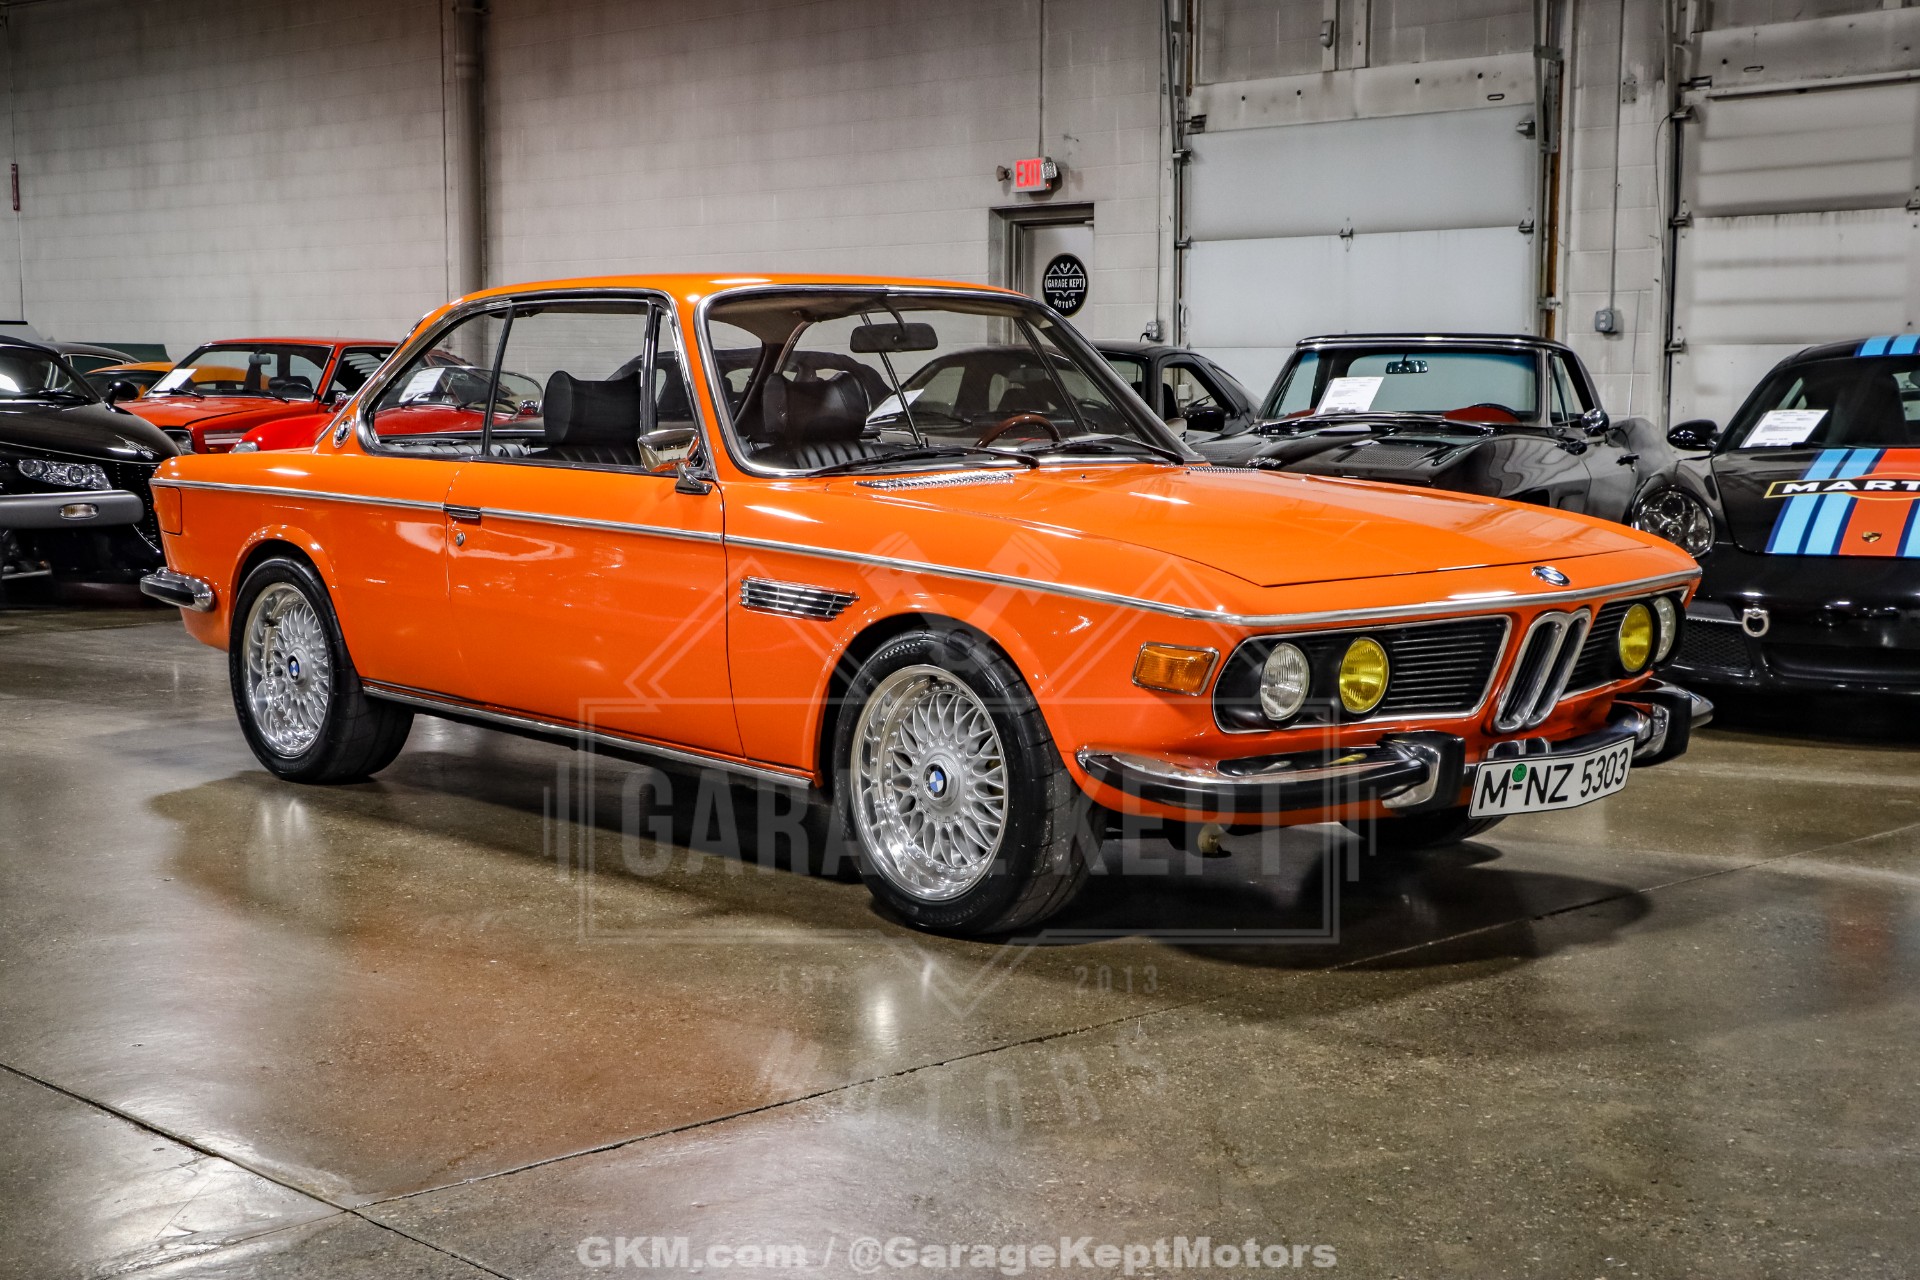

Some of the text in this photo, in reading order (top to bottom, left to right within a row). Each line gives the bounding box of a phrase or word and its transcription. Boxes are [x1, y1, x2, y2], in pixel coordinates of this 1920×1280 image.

[1015, 158, 1042, 187] EXIT
[1047, 278, 1083, 288] GARAGE KEPT
[1053, 298, 1077, 309] MOTORS
[1580, 747, 1629, 798] 5303
